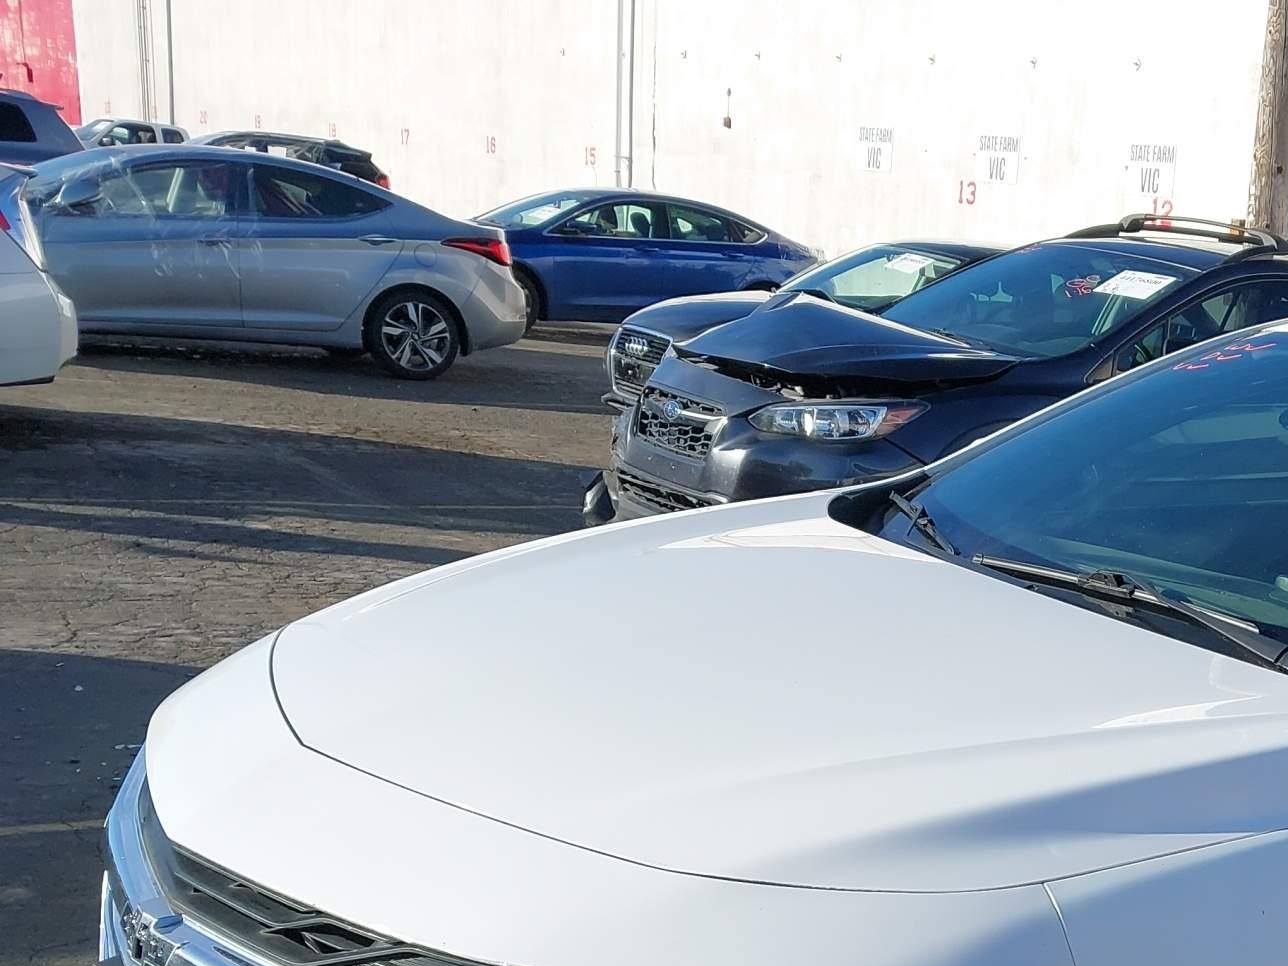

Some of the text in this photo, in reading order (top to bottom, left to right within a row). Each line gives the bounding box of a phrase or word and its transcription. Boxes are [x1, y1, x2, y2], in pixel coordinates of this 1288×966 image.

[858, 127, 892, 143] STATE FARM
[979, 135, 1019, 153] STATE FARM
[584, 146, 597, 166] 15
[867, 147, 882, 170] VIC
[1130, 144, 1175, 164] STATE FARM
[989, 157, 1006, 181] VIC
[1140, 167, 1160, 194] VIC
[957, 180, 977, 206] 13
